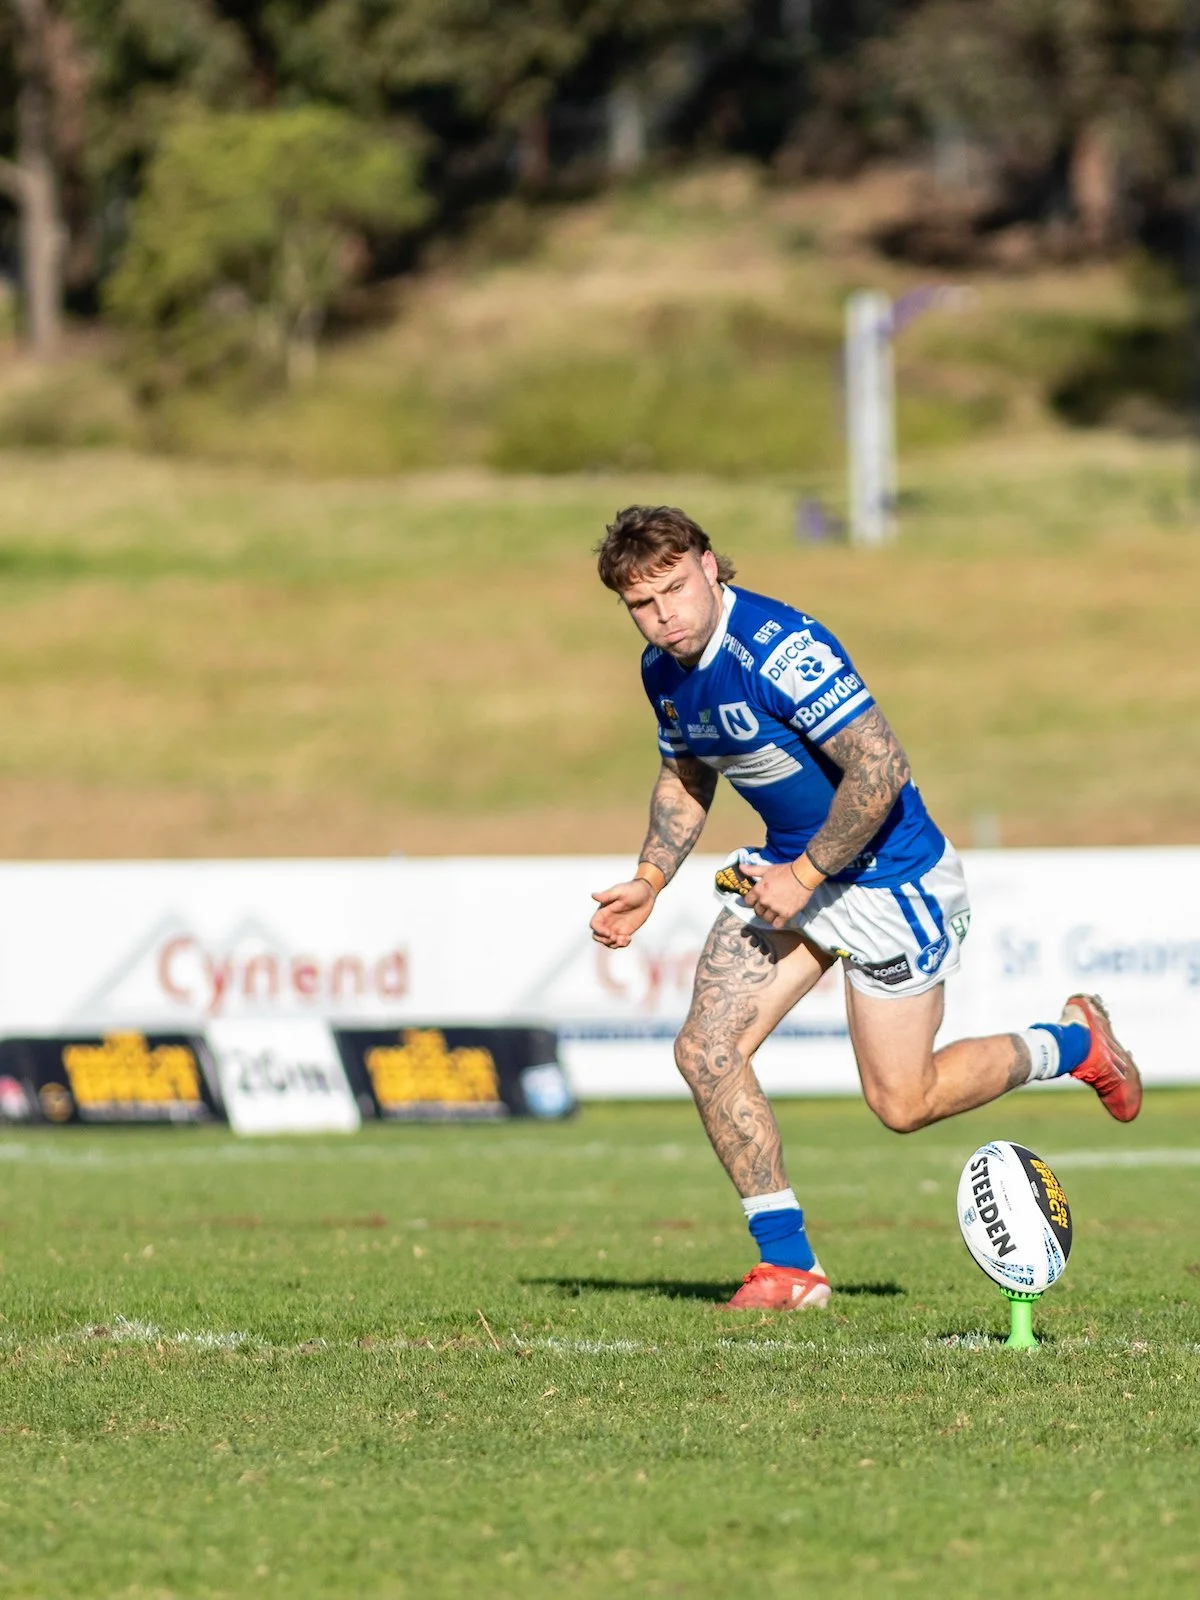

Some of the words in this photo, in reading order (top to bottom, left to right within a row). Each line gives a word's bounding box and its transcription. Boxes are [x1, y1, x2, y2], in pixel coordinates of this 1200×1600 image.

[753, 620, 781, 644] GFS
[724, 707, 753, 735] N
[157, 932, 410, 1015] Cynend
[873, 961, 908, 977] FORCE
[970, 1157, 1018, 1258] STEEDEN
[1030, 1159, 1062, 1226] EFFECT
